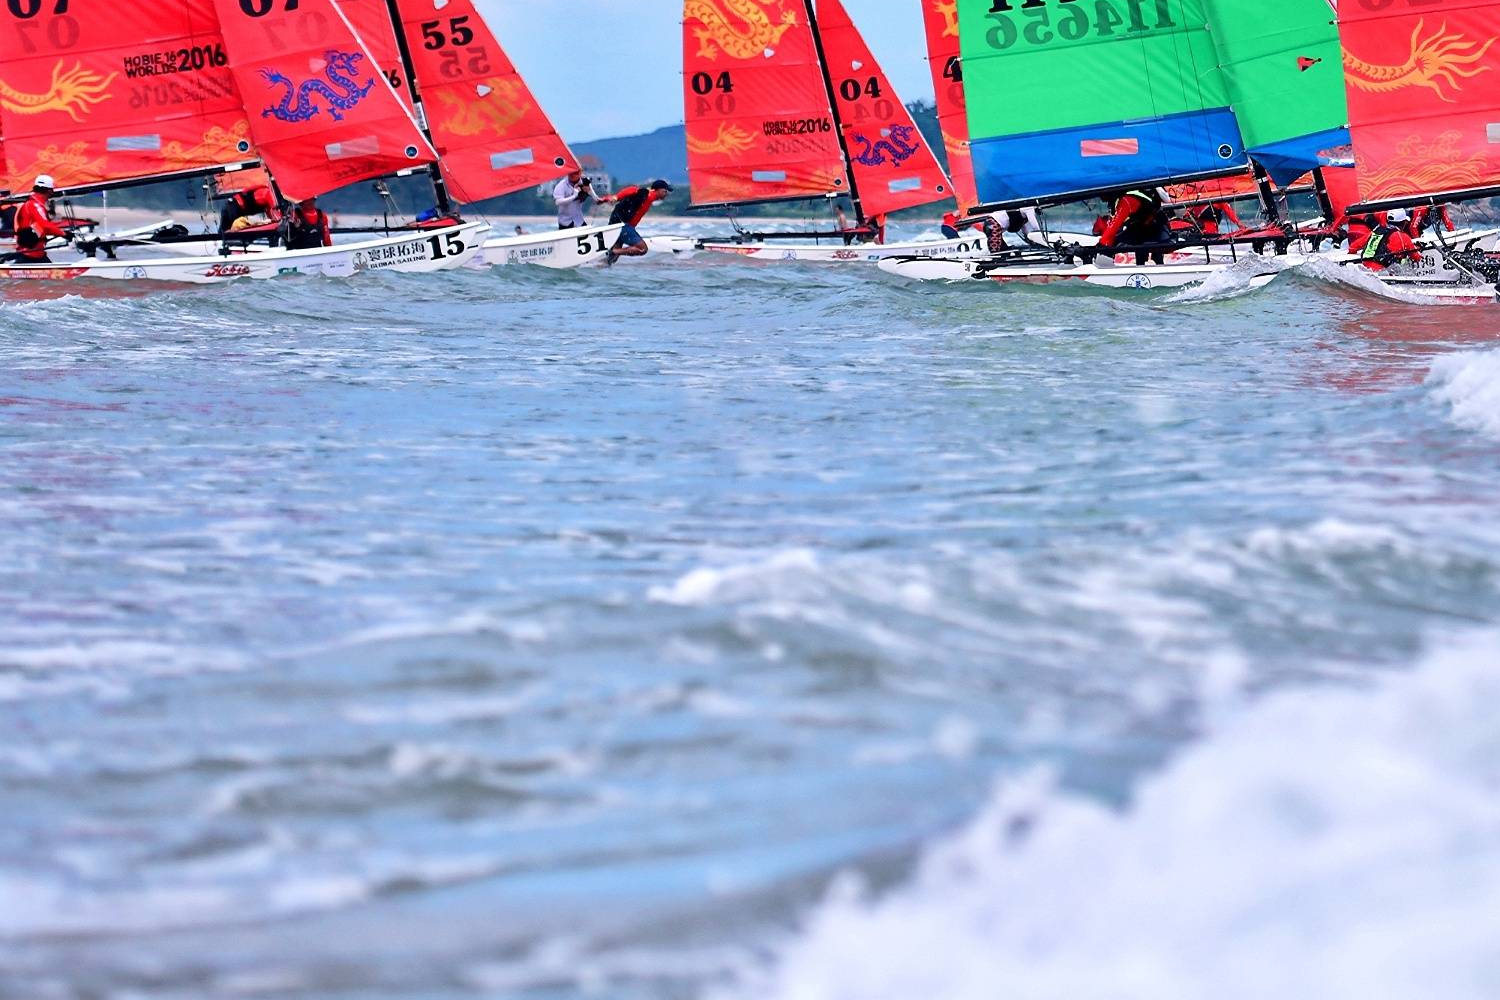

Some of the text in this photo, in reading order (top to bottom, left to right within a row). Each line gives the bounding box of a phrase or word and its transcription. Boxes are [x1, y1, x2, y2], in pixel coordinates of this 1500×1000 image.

[421, 15, 474, 51] 55
[123, 50, 177, 68] HOBIE 16
[124, 43, 229, 79] WORLDS 2016
[691, 71, 734, 95] 04
[840, 76, 882, 101] 04
[797, 117, 831, 134] 2016
[427, 230, 465, 260] 15
[576, 231, 608, 255] 51
[370, 255, 427, 269] GLOBAL SAILING
